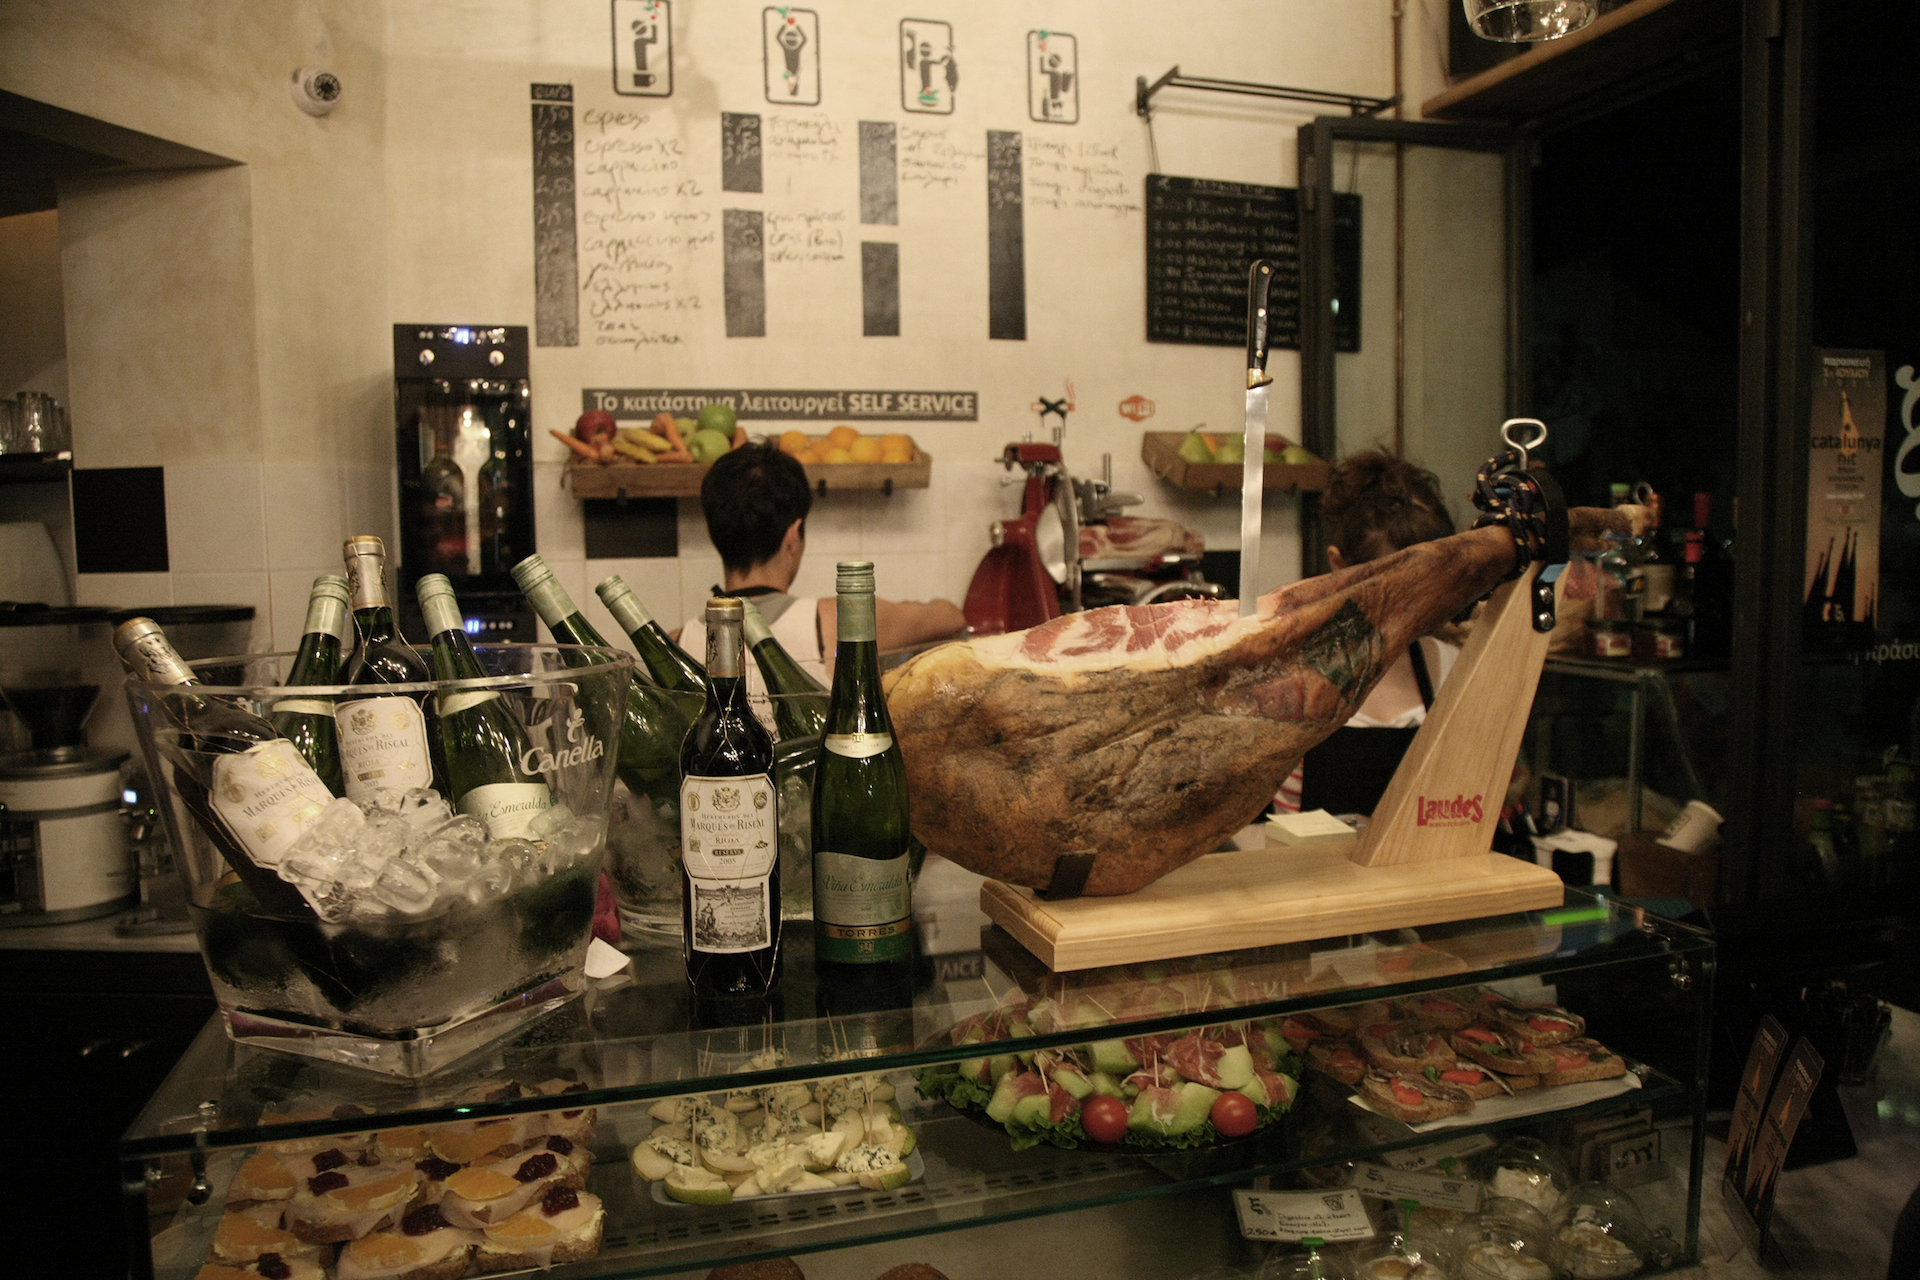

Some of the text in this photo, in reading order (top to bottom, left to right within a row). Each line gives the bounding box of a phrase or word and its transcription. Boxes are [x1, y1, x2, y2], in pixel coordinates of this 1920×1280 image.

[534, 87, 570, 98] euro
[594, 391, 618, 409] Το
[742, 391, 844, 416] λειτουργεί
[849, 393, 893, 413] SELF
[899, 394, 975, 414] SERVICE
[1811, 434, 1880, 453] catalunya
[521, 735, 604, 776] Canella
[489, 797, 547, 818] Esmeralda
[737, 818, 765, 830] RISCAL
[850, 874, 902, 892] Esmeralda
[837, 927, 896, 938] TORRES
